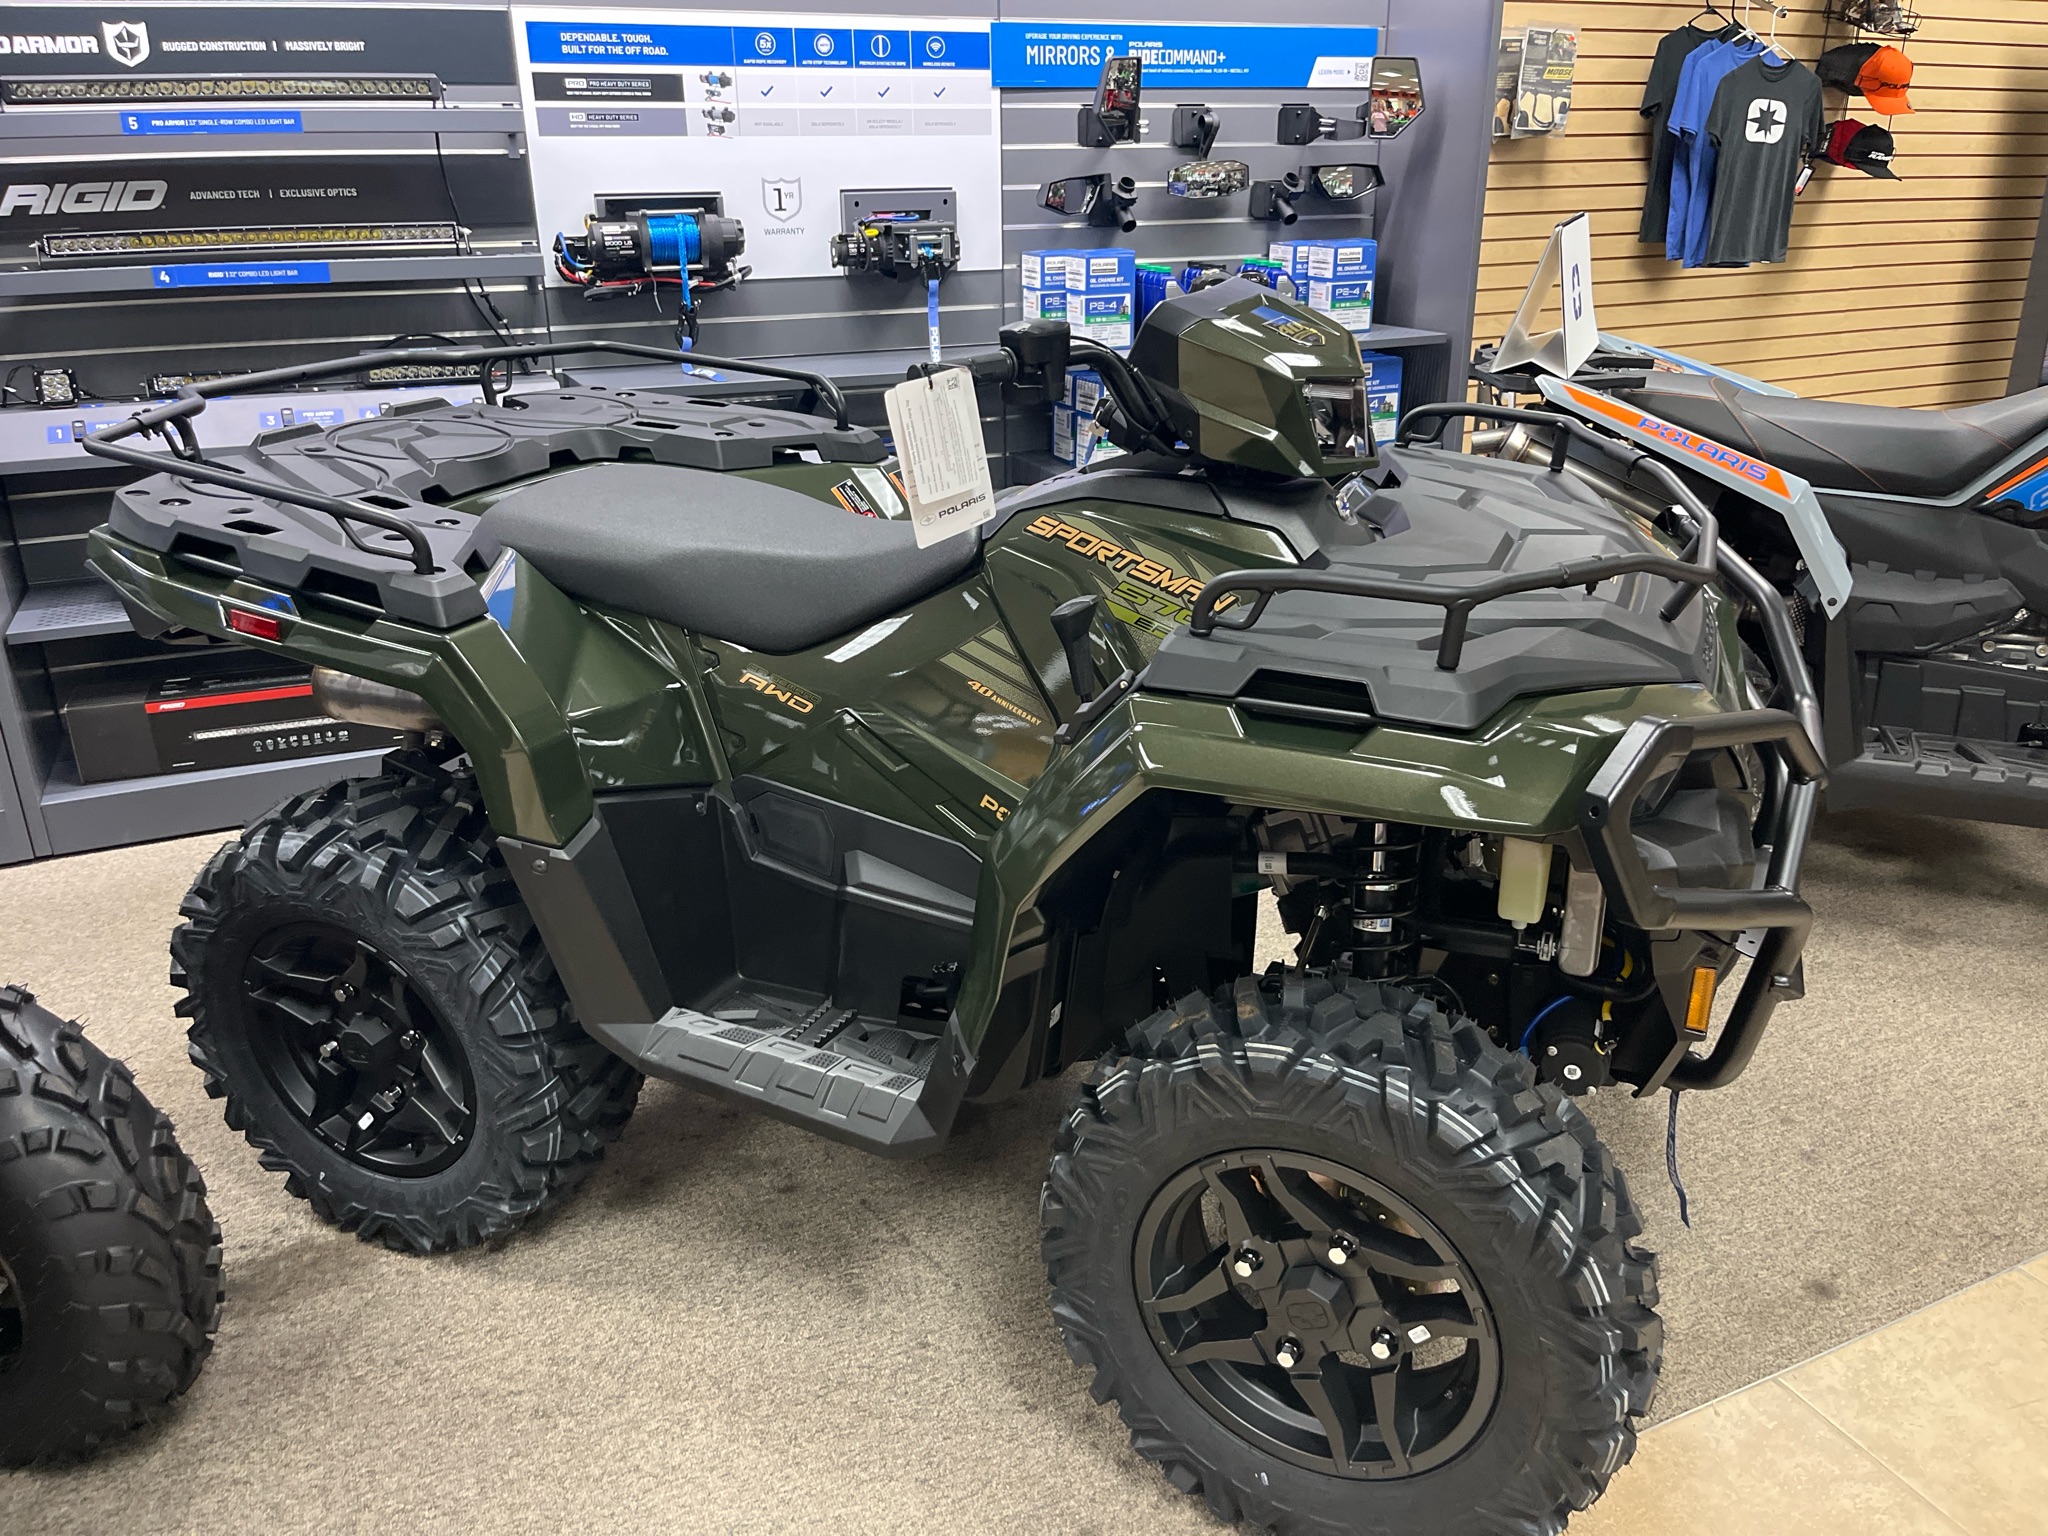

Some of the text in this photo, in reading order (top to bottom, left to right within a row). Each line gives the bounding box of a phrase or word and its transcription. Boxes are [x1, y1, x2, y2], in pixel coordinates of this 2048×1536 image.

[12, 36, 99, 54] ARMOR
[560, 33, 653, 43] DEPENDABLE. TOUGH.
[162, 41, 365, 51] RUGGED CONSTRUCTION MASSIVELY BRIGHT
[561, 45, 669, 56] BUILT FOR THE OFF ROAD.
[1026, 45, 1100, 65] MIRRORS
[128, 117, 139, 130] 5
[0, 180, 168, 217] RIGID
[190, 188, 357, 200] ADVANCED TECH EXCLUSIVE OPTICS
[773, 187, 787, 212] 1
[764, 227, 805, 236] WARRANTY
[159, 270, 170, 284] 4
[266, 415, 276, 426] 3
[55, 428, 63, 439] 1
[1638, 416, 1768, 482] POLARIS
[938, 493, 986, 518] POLARIS
[739, 673, 814, 714] AWD
[967, 680, 1042, 726] 40 ANNIVERSARY
